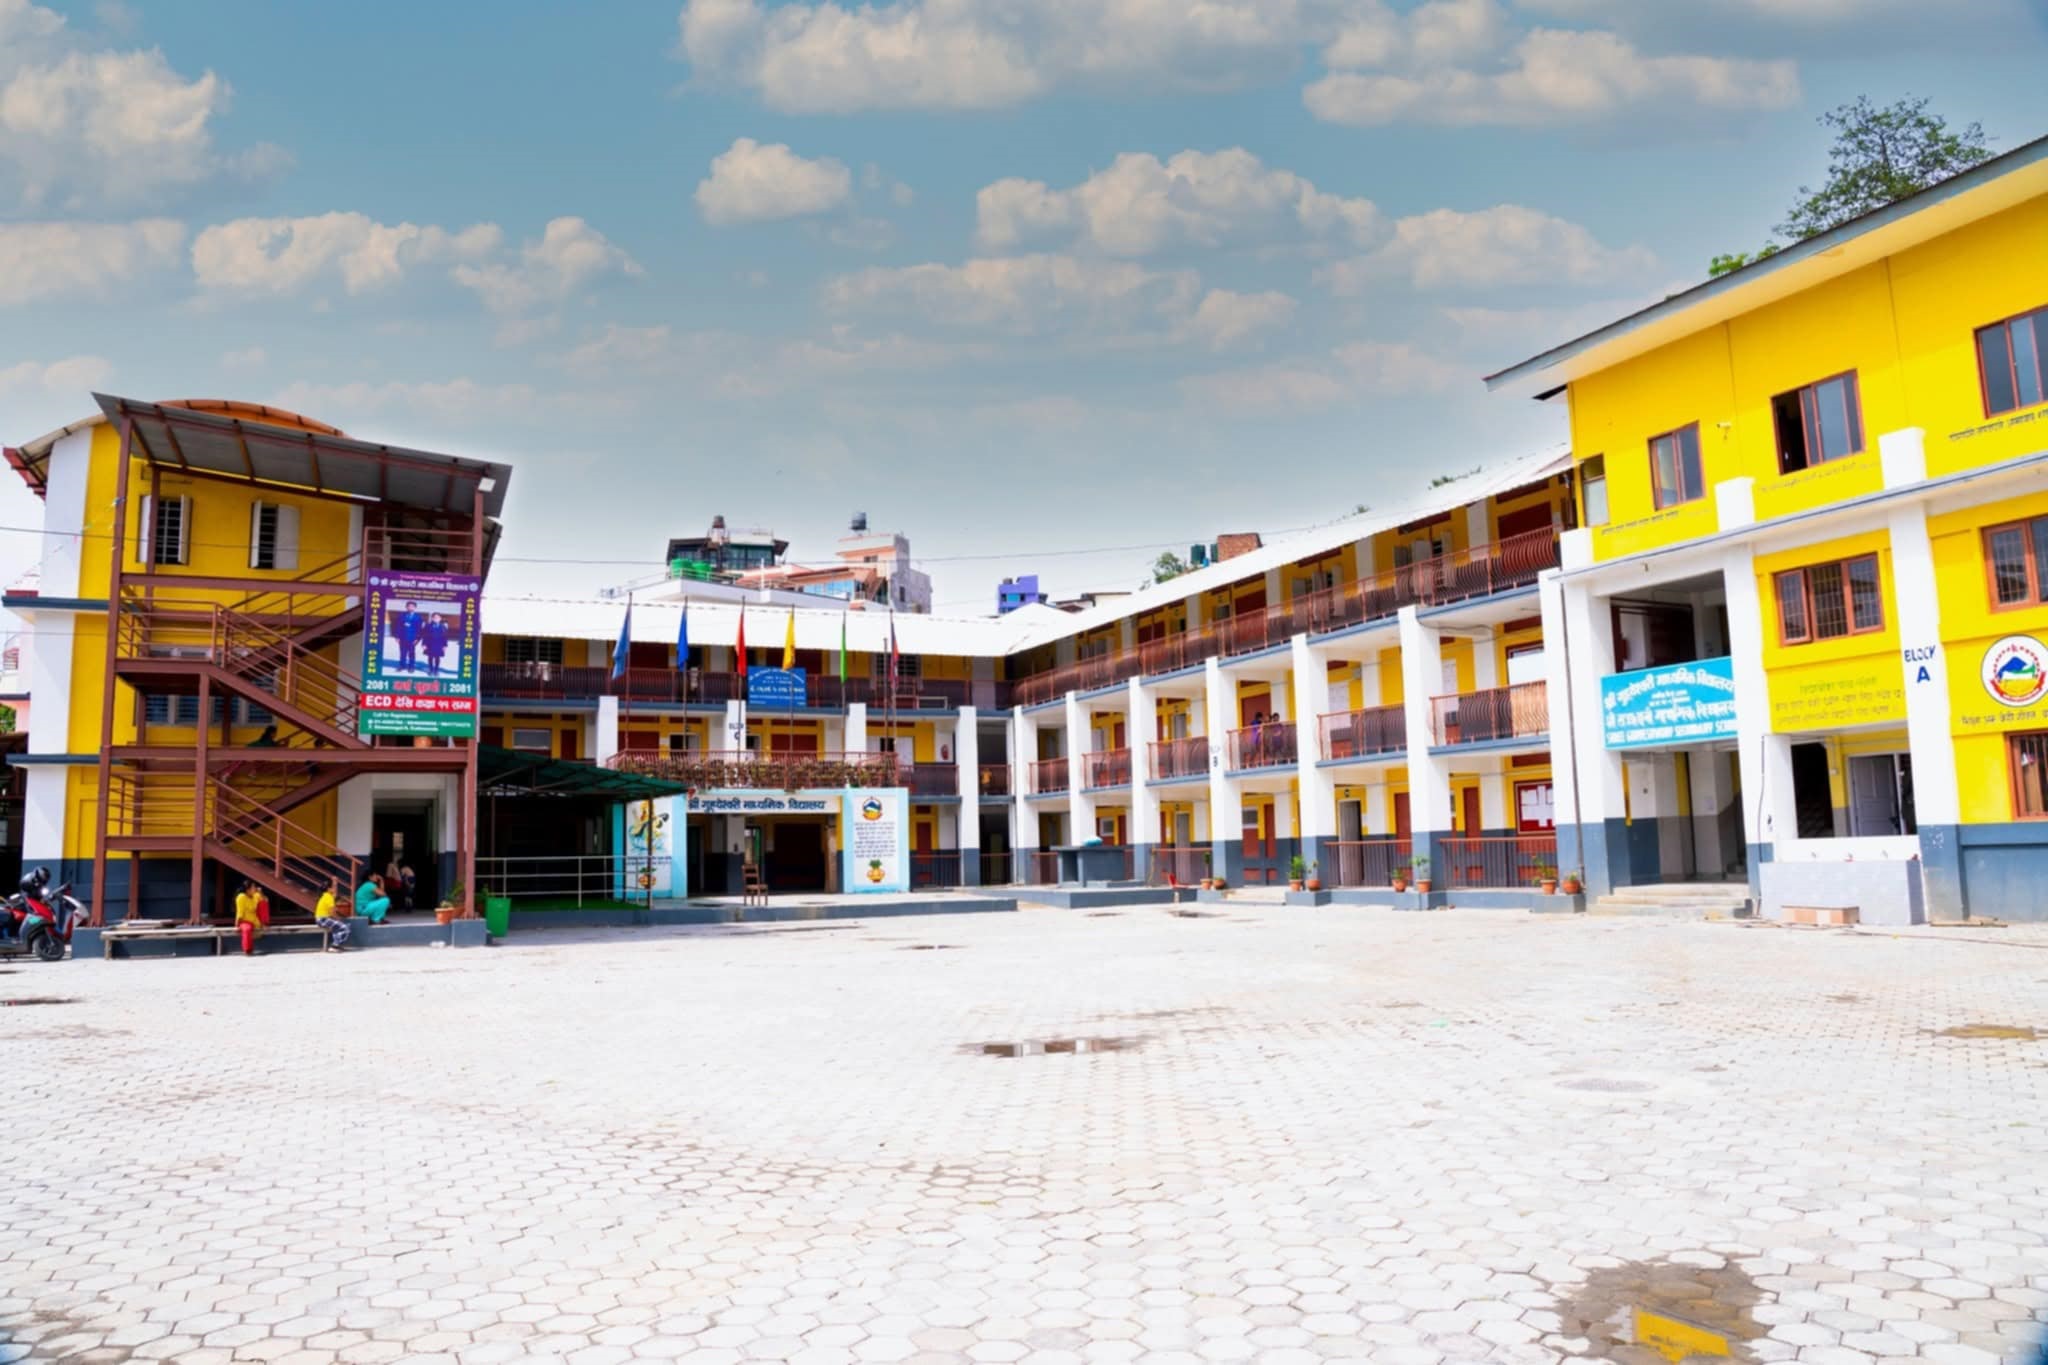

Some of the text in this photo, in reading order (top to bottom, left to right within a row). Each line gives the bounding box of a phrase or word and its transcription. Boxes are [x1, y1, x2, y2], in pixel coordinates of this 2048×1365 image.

[367, 650, 377, 673] OPEN
[463, 654, 472, 679] OPEN
[1917, 665, 1930, 683] A
[366, 680, 389, 691] 2081
[449, 683, 471, 694] 2081
[366, 695, 391, 707] ECD
